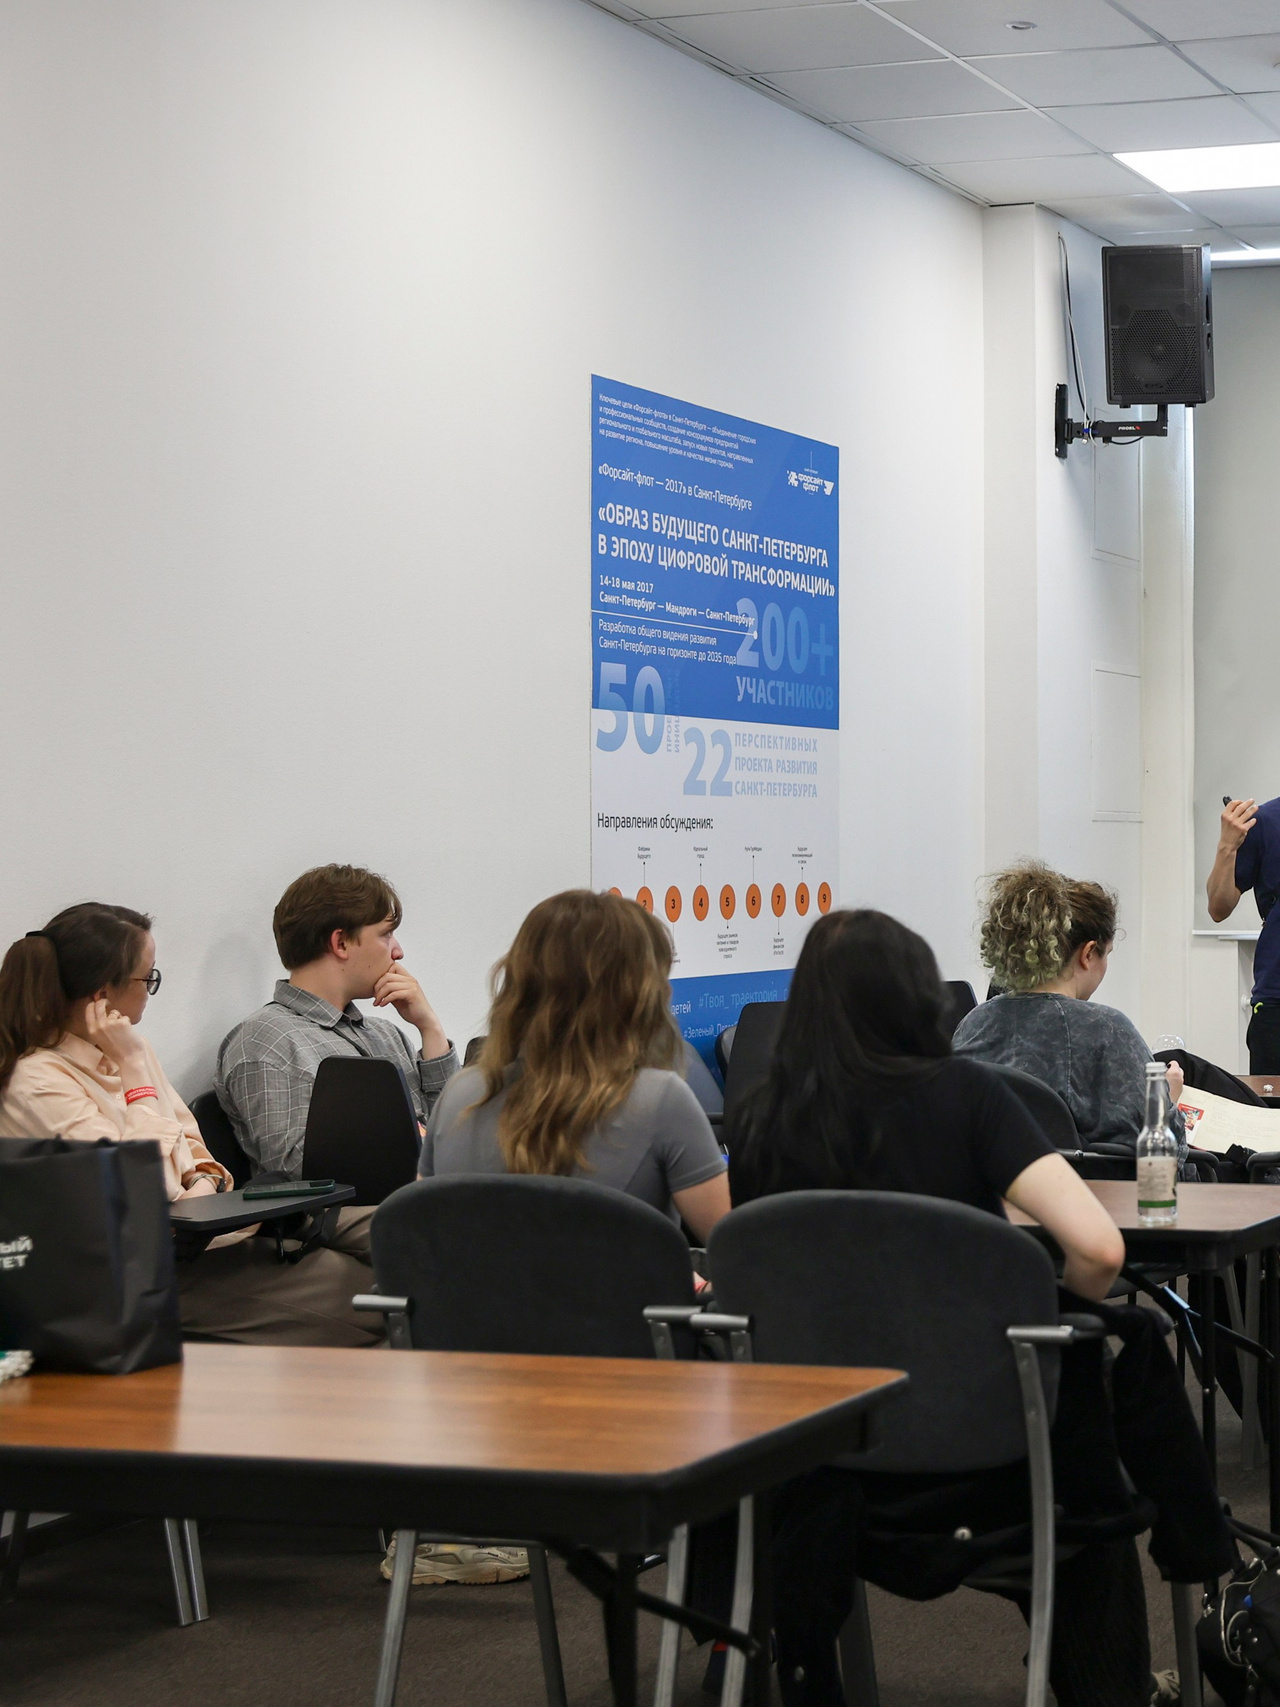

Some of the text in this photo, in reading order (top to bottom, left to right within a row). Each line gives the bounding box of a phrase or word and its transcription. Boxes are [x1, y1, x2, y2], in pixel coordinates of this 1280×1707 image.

[599, 463, 655, 487] «Форсайт-флот
[665, 479, 687, 494] 2017»
[688, 486, 693, 496] в
[694, 485, 752, 511] Санкт-Петербурге
[599, 503, 828, 568] «ОБРАЗ БУДУЩЕГО САНКТ-ПЕТЕРБУРГА
[599, 534, 835, 598] В ЭПОХУ ЦИФРОВОЙ ТРАНСФОРМАЦИИ»
[600, 574, 654, 593] 14-18 мая 2017
[600, 590, 656, 612] Санкт-Петербург
[666, 601, 697, 617] Мандроги
[706, 608, 756, 627] Санкт-Петербург
[599, 619, 717, 646] Разработка общего видения развития
[736, 597, 834, 677] 200+
[599, 636, 736, 666] Санкт-Петербурга на горизонте до 2035 года
[596, 661, 666, 755] 50
[735, 675, 834, 710] УЧАСТНИКОВ
[735, 733, 818, 753] ПЕРСПЕКТИВНЫХ
[683, 727, 733, 797] 22
[735, 757, 818, 775] ПРОЕКТА РАЗВИТИЯ
[735, 781, 818, 798] САНКТ-ПЕТЕРБУРГА
[598, 813, 713, 832] Направления обсуждения:
